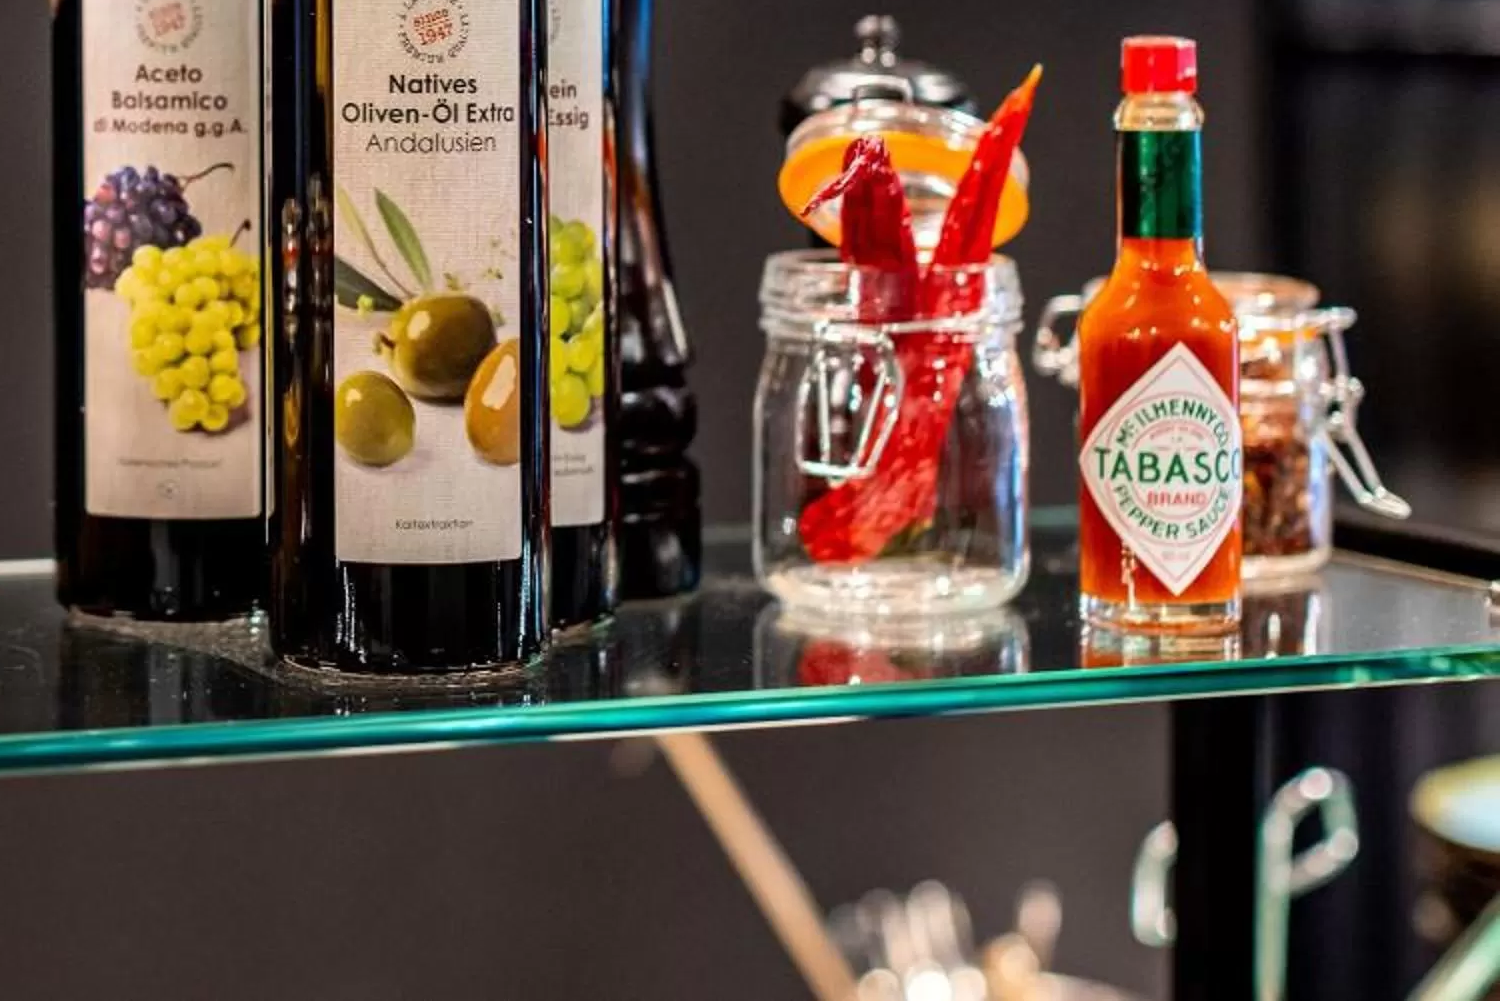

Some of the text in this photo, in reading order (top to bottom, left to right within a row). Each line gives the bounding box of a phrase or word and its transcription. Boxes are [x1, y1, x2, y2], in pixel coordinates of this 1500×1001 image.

[135, 63, 203, 84] Aceto
[388, 74, 478, 94] Natives
[111, 90, 229, 111] Balsamico
[341, 97, 516, 124] Oliven-Öl Extra
[112, 117, 189, 134] Modena
[365, 131, 497, 154] Andalusien
[1094, 447, 1241, 484] TABASCO
[1147, 490, 1207, 507] BRAND
[1114, 485, 1230, 540] PEPPER SAUCE
